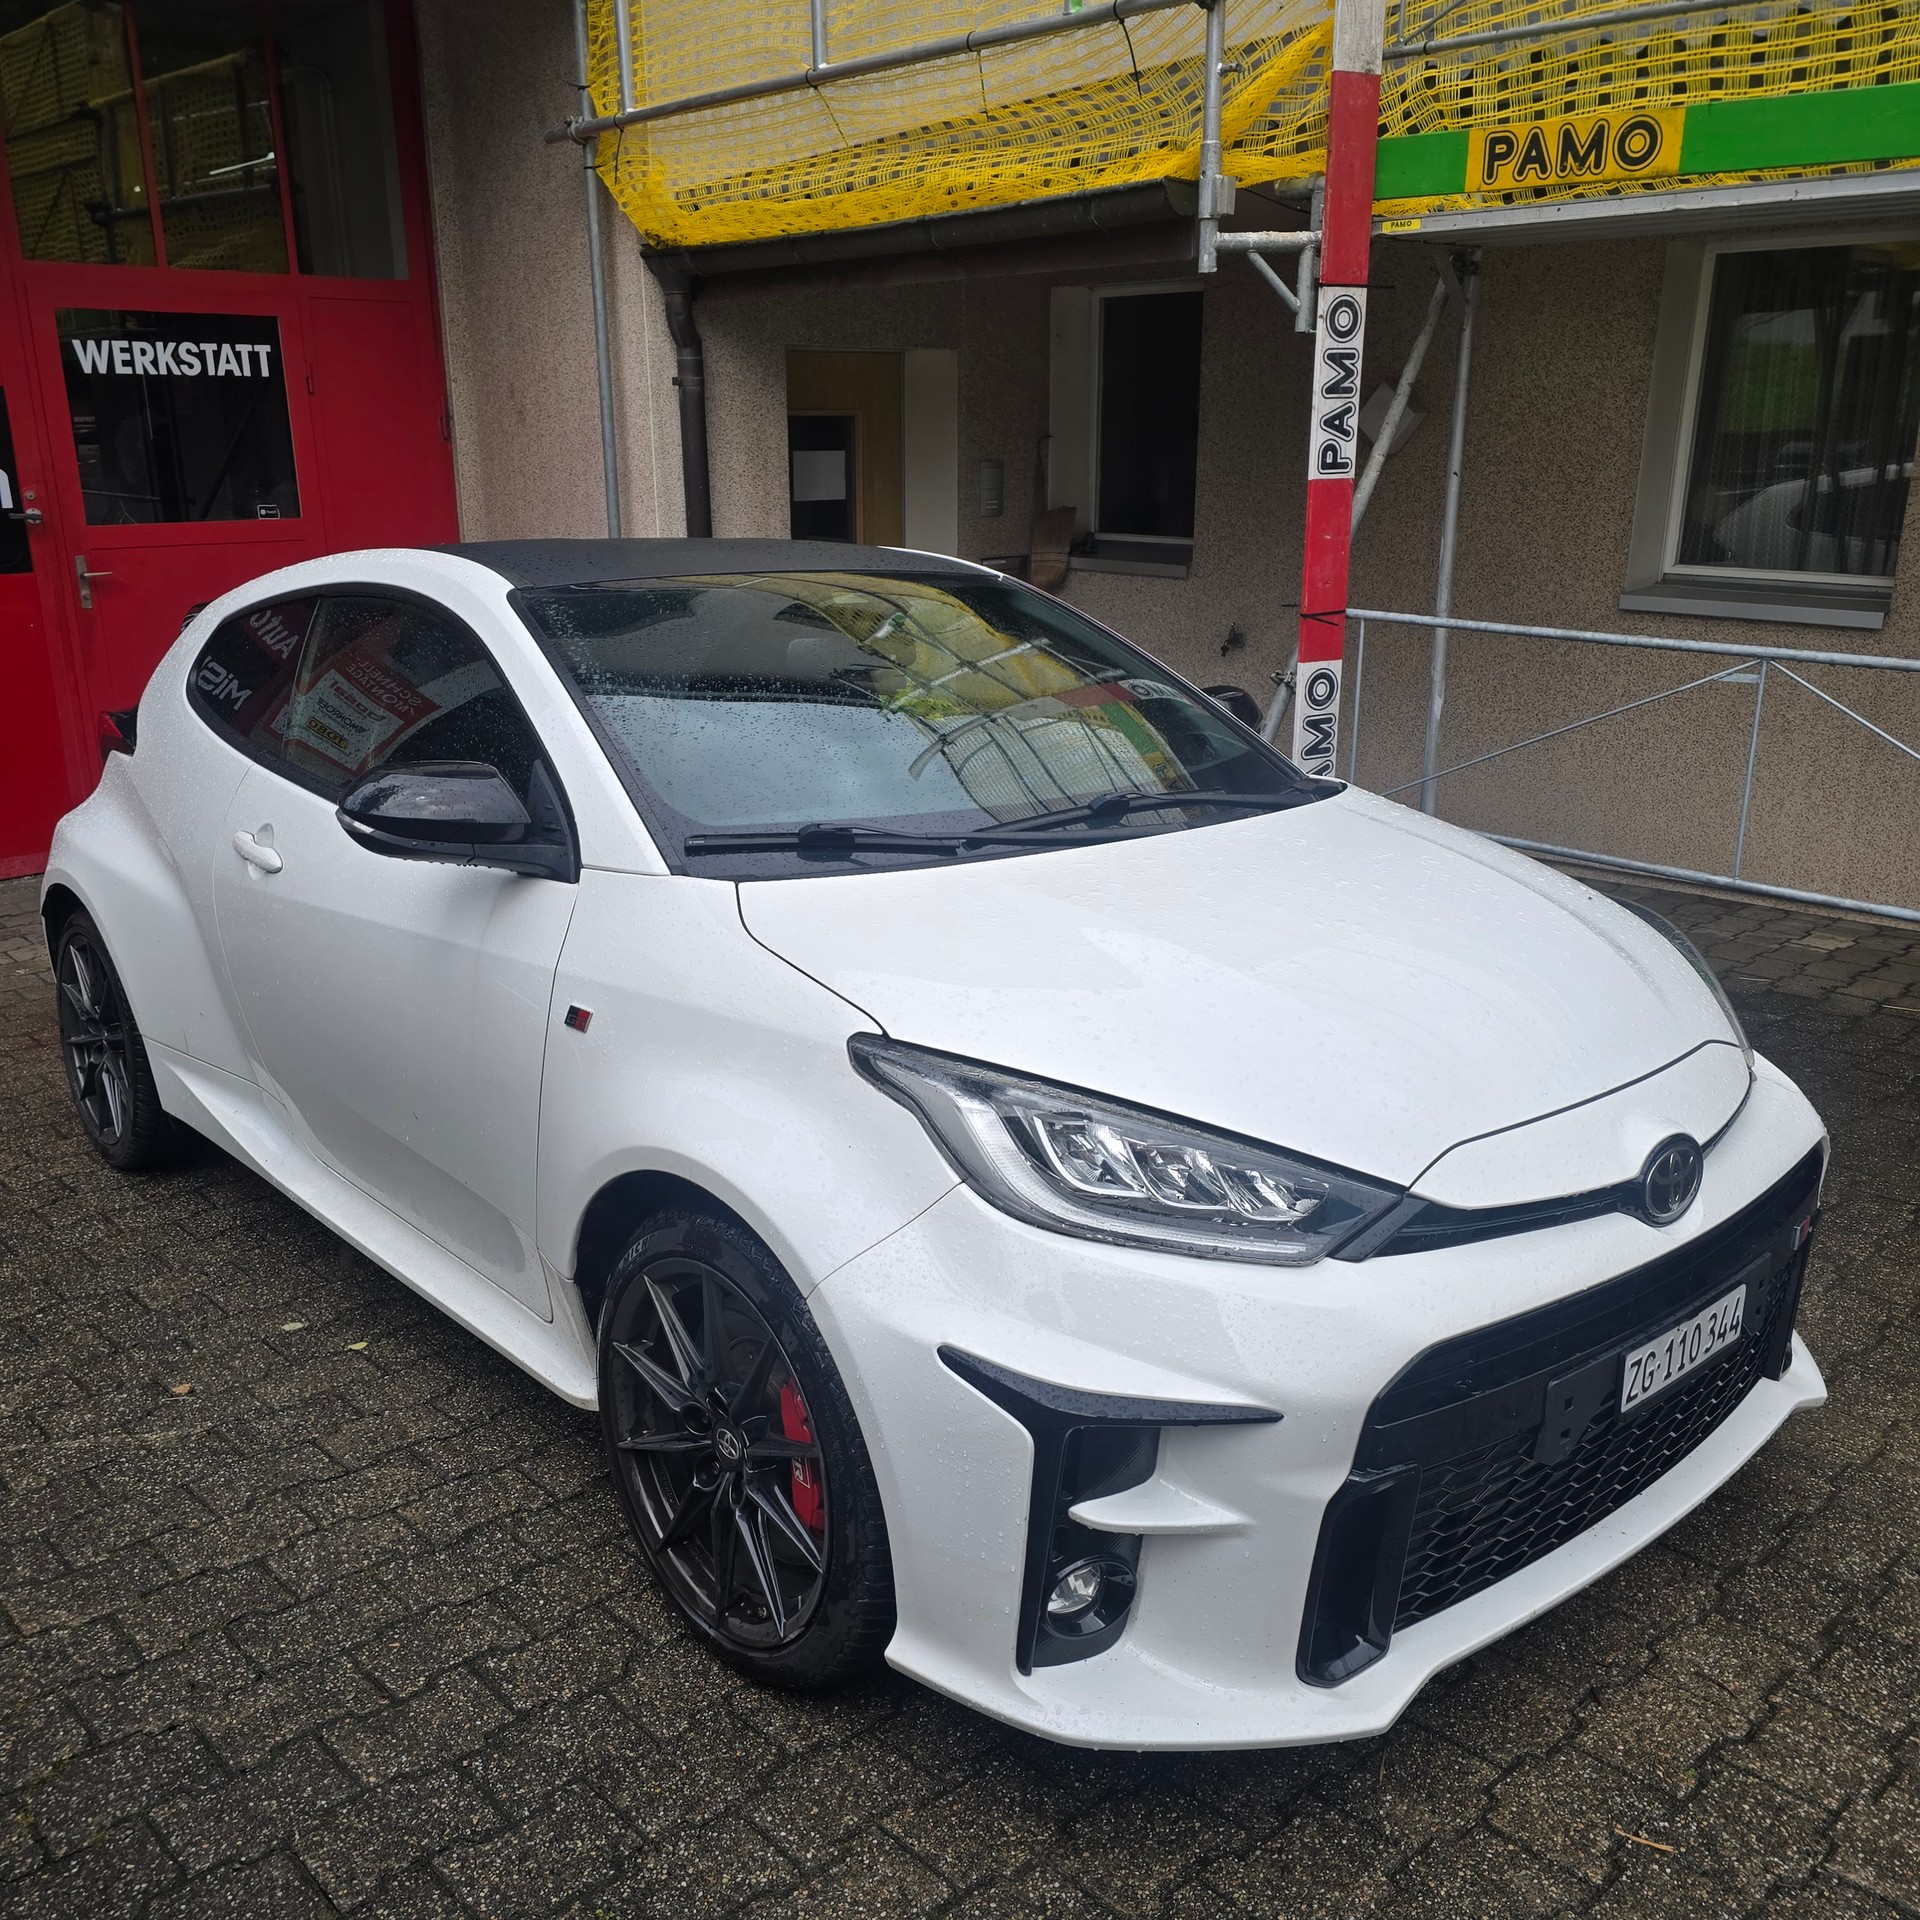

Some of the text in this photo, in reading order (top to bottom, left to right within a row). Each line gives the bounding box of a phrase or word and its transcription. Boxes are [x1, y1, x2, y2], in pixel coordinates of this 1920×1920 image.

[1482, 114, 1663, 186] PAMO
[1390, 220, 1413, 229] PAMO
[71, 339, 272, 377] WERKSTATT
[1317, 294, 1363, 475] PAMO
